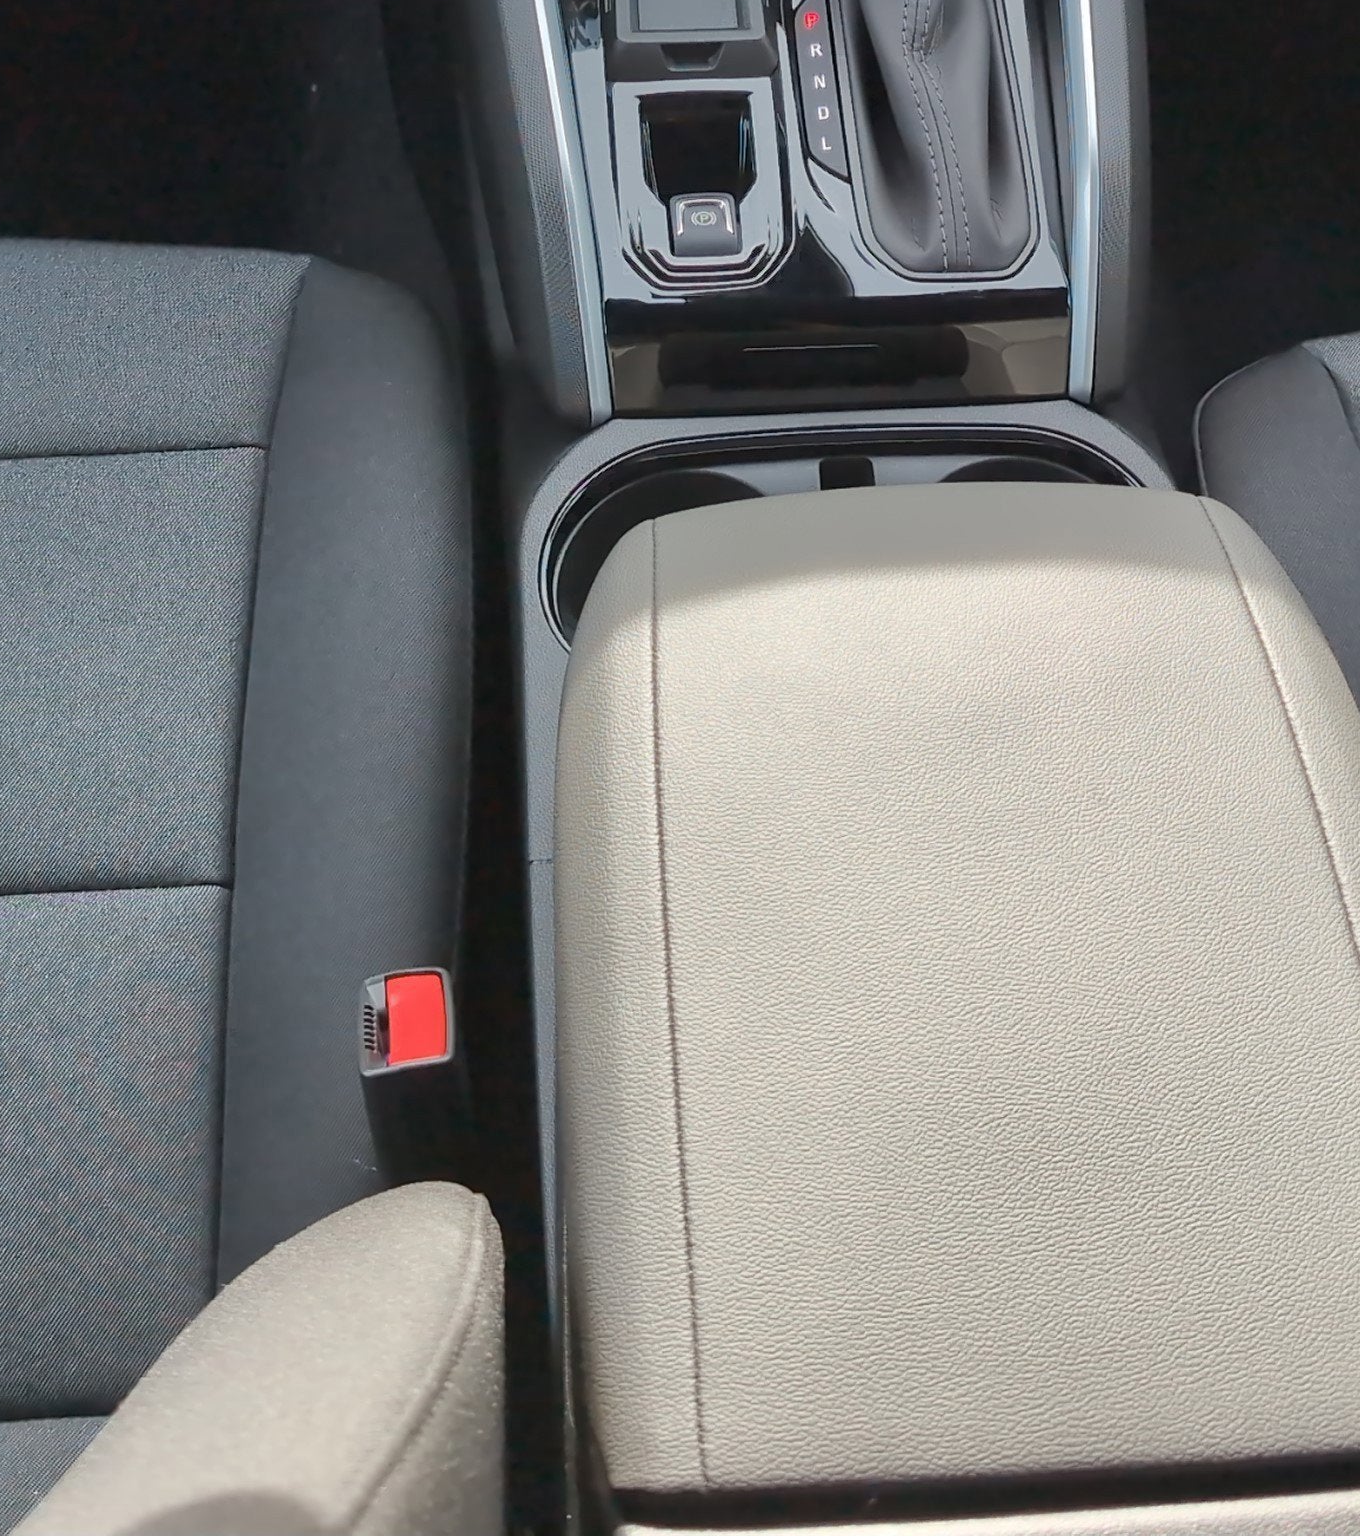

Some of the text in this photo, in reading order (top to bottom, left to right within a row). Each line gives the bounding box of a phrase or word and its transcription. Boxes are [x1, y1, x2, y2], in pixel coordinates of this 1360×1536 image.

[804, 12, 820, 30] P
[810, 43, 823, 58] R
[814, 74, 827, 89] N
[818, 106, 830, 121] D
[821, 137, 832, 151] L
